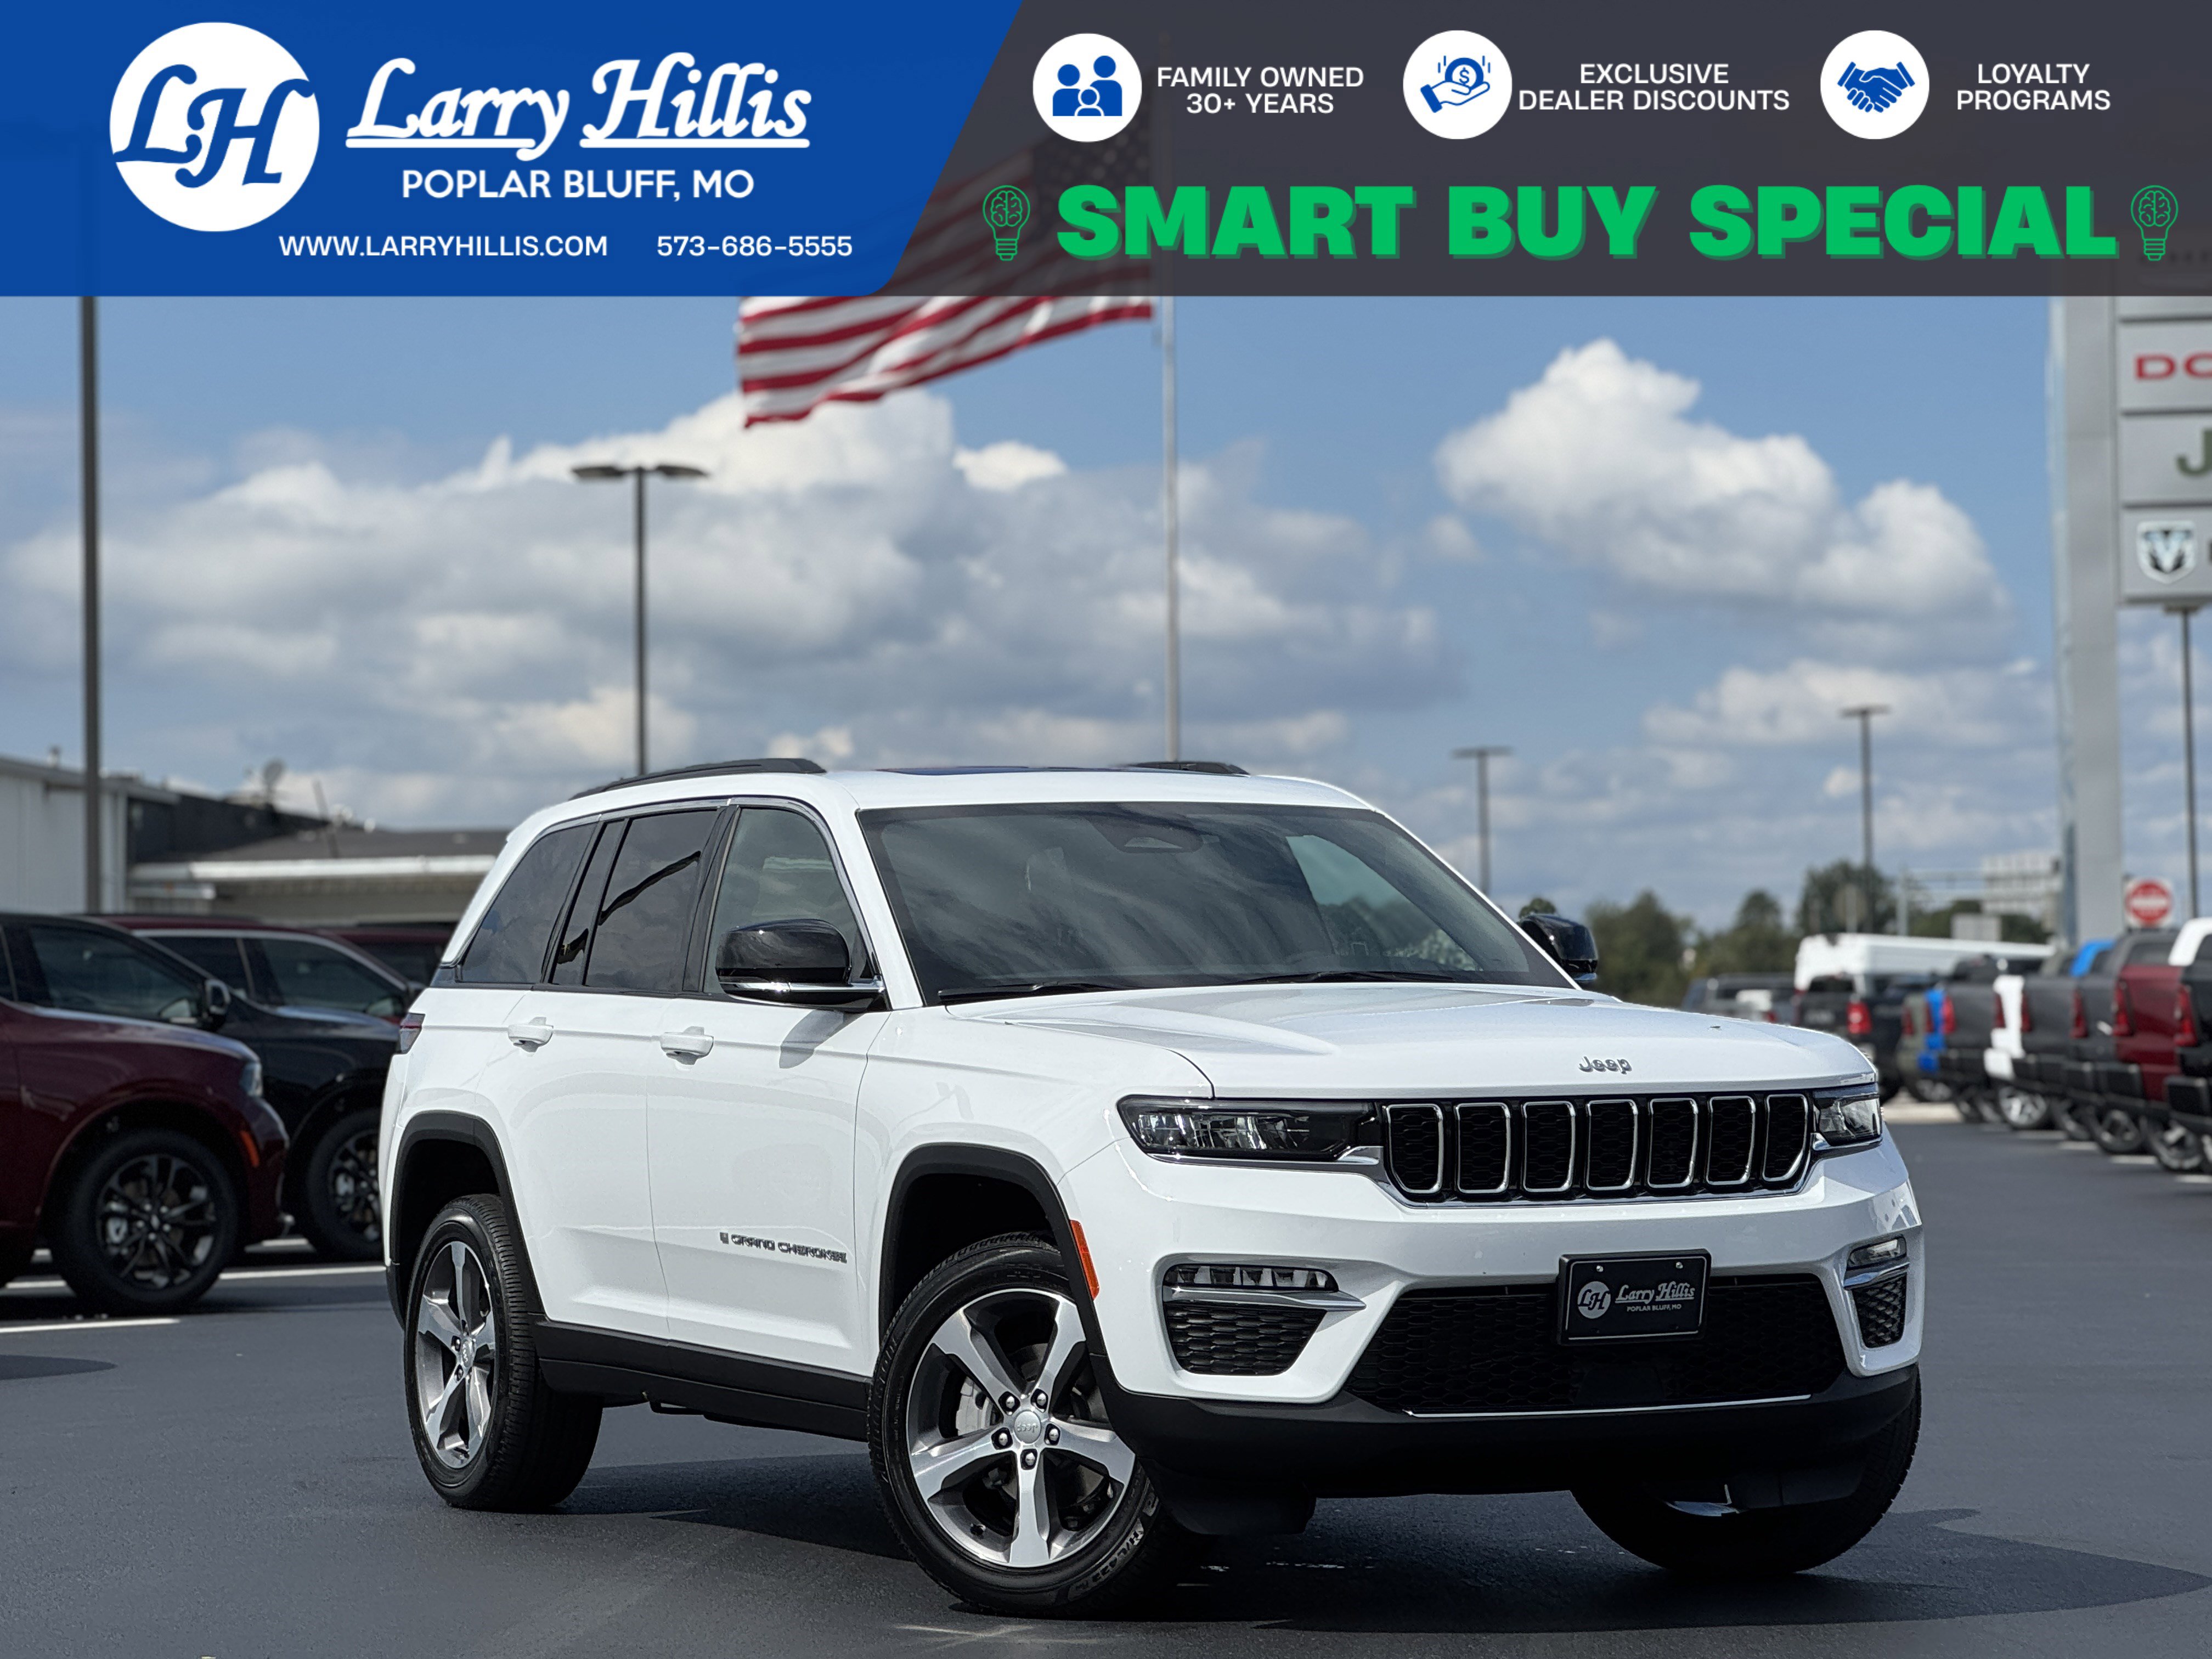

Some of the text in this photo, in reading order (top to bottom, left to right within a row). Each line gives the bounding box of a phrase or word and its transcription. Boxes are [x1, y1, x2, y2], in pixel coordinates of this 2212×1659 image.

[1578, 1056, 1632, 1075] Jeep
[731, 1234, 847, 1263] GRAND CHEROKEE
[1615, 1280, 1695, 1305] Larry Hillis
